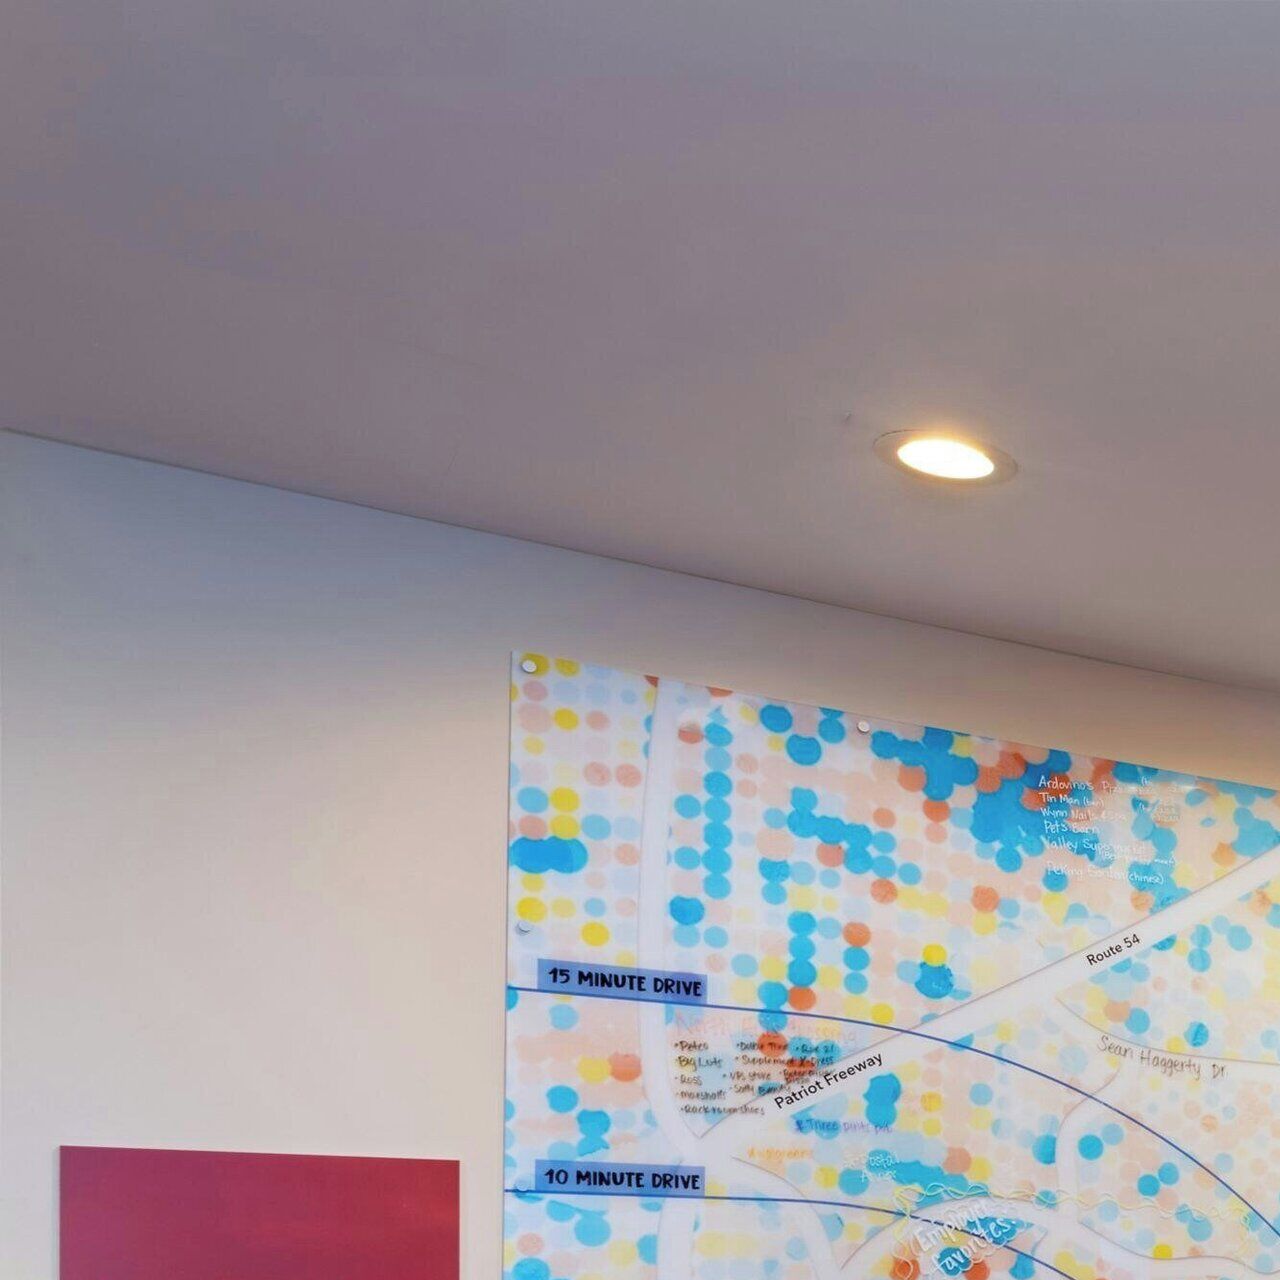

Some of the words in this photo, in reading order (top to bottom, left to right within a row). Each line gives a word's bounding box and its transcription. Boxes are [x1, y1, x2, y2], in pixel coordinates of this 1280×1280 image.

[1086, 945, 1123, 966] Route
[1123, 933, 1141, 949] 54
[549, 967, 570, 984] 15
[578, 970, 646, 992] MINUTE
[653, 977, 702, 997] DRIVE
[1140, 1050, 1201, 1081] Haggerty
[774, 1081, 823, 1110] Patriot
[822, 1053, 884, 1087] Freeway
[544, 1168, 569, 1185] 10
[576, 1170, 645, 1188] MINUTE
[652, 1173, 700, 1190] DRIVE
